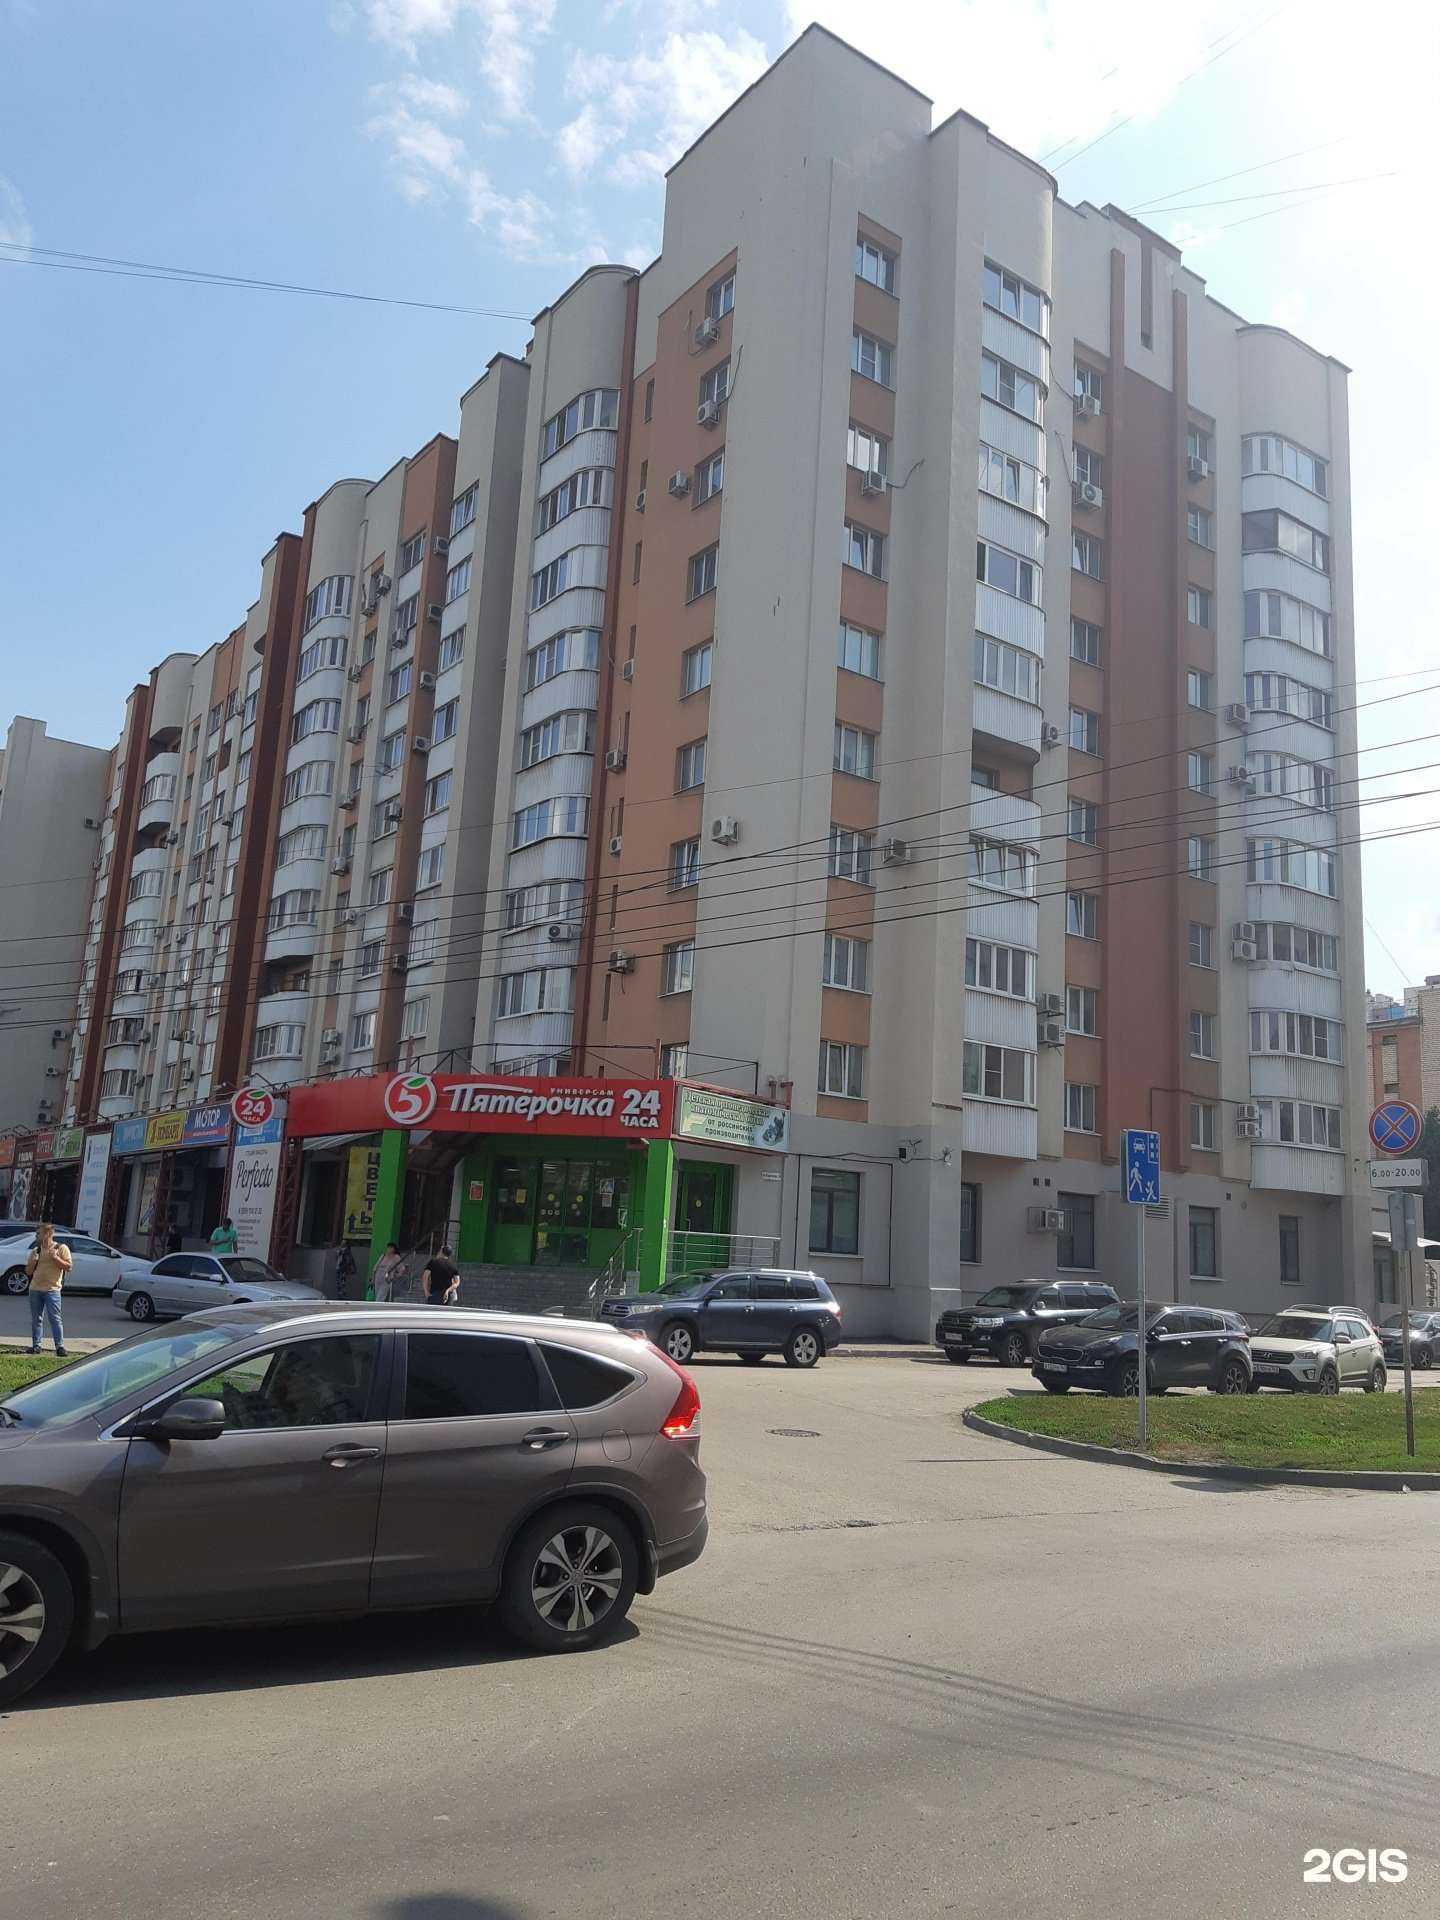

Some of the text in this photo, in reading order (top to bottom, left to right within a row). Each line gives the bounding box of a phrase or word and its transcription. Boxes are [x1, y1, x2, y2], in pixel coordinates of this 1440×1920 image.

[550, 1087, 614, 1097] УНИВЕРСАМ
[240, 1100, 265, 1117] 24
[622, 1088, 661, 1115] 24
[194, 1107, 221, 1129] МОТОР
[620, 1115, 659, 1128] ЧАСА
[717, 1120, 753, 1132] российских
[235, 1160, 274, 1202] Perfecto
